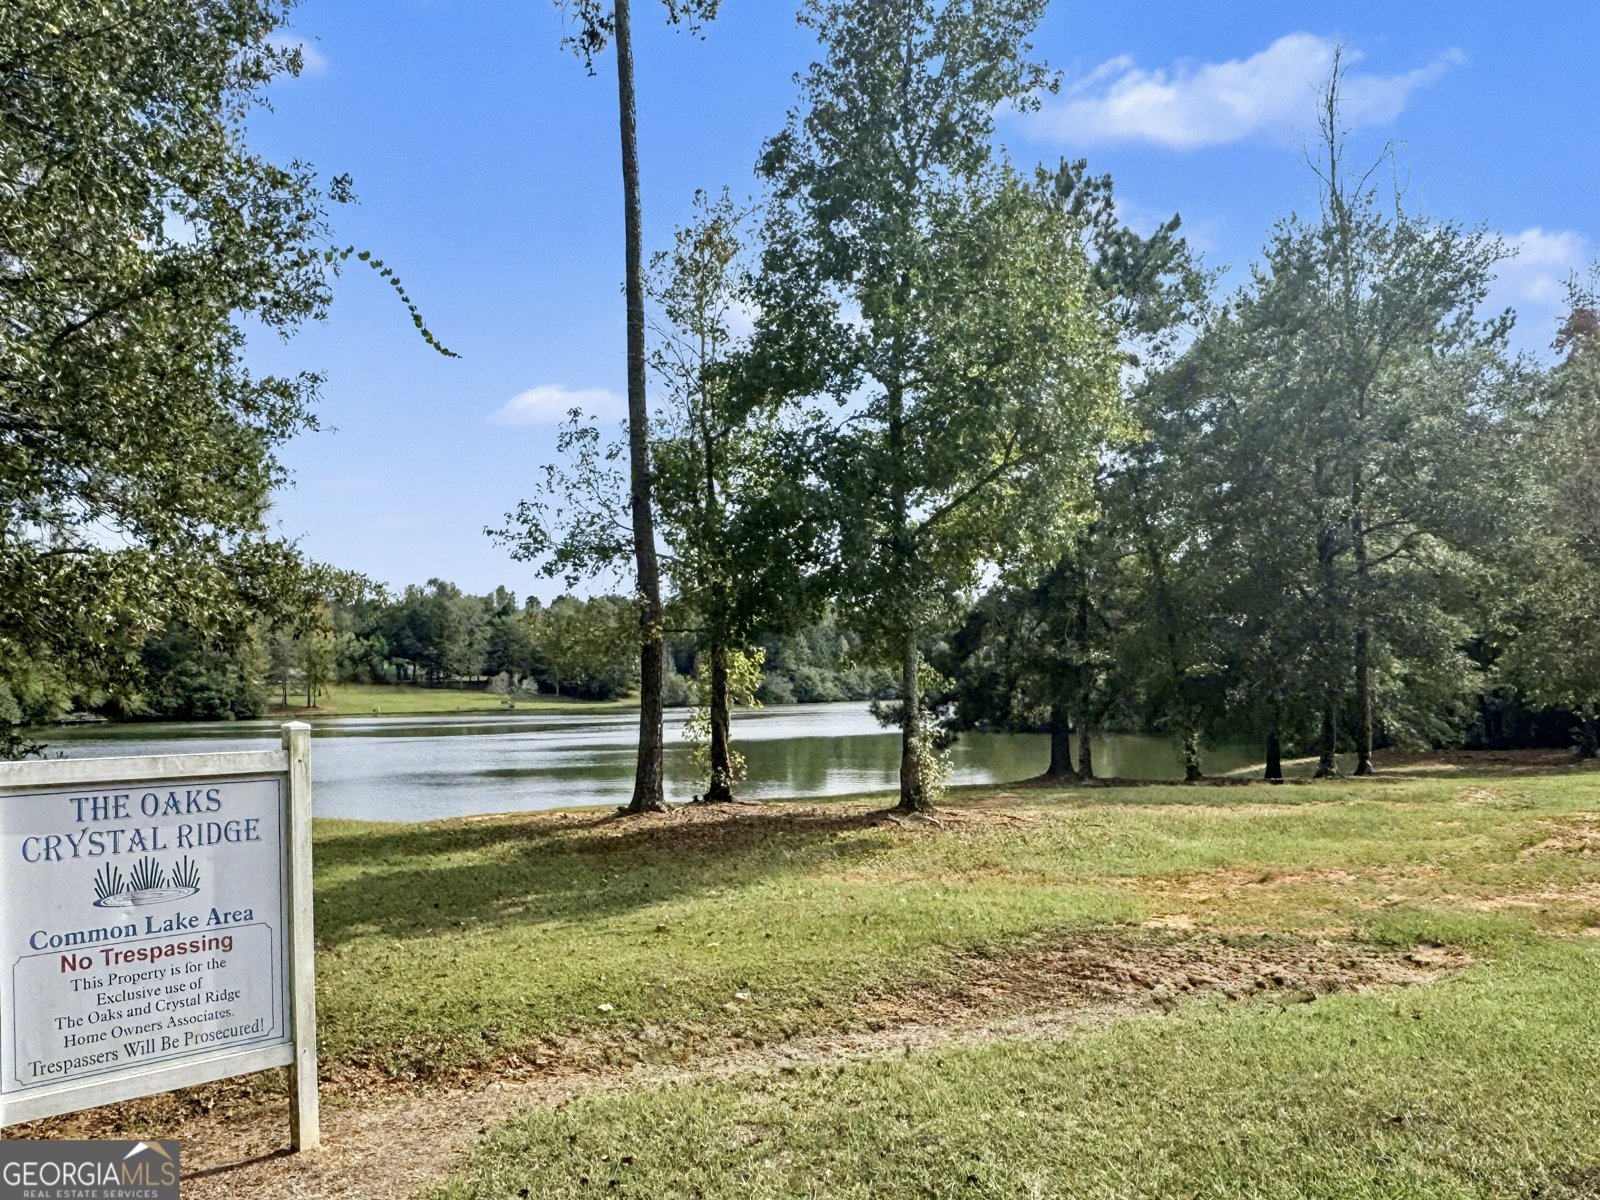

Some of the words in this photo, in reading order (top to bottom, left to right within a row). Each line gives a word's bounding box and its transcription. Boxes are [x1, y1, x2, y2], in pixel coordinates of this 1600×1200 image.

[69, 794, 130, 822] THE
[140, 789, 222, 817] OAKS
[22, 826, 167, 863] CRYSTAL
[176, 818, 262, 849] RIDGE
[29, 923, 137, 951] Common
[145, 912, 200, 934] Lake
[206, 907, 254, 926] Area
[61, 953, 93, 973] No
[100, 935, 233, 966] Trespassing
[70, 976, 103, 992] This
[108, 968, 166, 985] Property
[170, 964, 181, 976] is
[185, 961, 203, 974] for
[207, 958, 227, 970] the
[96, 986, 161, 1006] Exclusive
[165, 983, 186, 995] use
[189, 977, 203, 990] of
[54, 1016, 84, 1030] The
[88, 1009, 123, 1024] Oaks
[126, 1002, 151, 1018] and
[155, 994, 201, 1012] Crystal
[205, 989, 241, 1003] Ridge
[28, 1050, 119, 1078] Trespassers
[123, 1039, 156, 1058] Will
[160, 1036, 180, 1052] Be
[184, 1018, 265, 1047] Prosecuted!
[64, 1032, 107, 1048] Home
[111, 1021, 163, 1039] Owners
